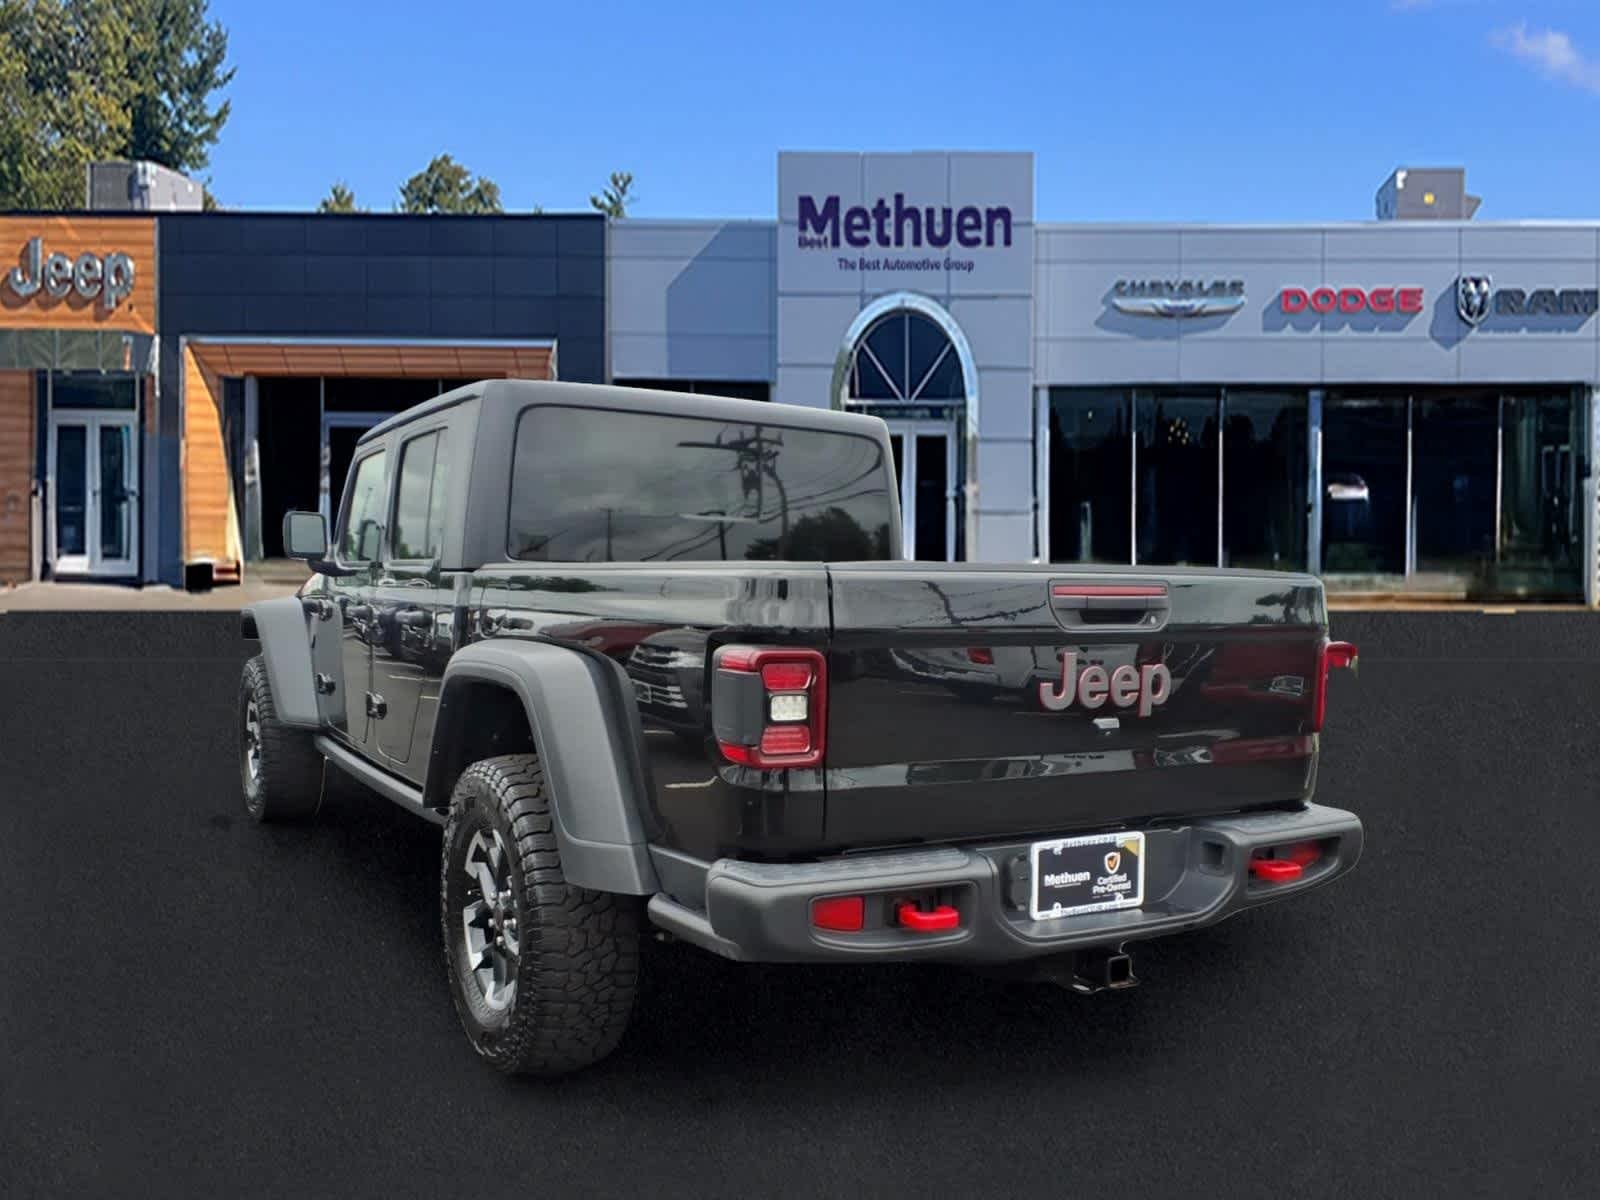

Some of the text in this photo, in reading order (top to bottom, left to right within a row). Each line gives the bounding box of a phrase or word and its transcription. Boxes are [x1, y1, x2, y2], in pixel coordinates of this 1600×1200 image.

[798, 193, 1012, 248] Methuen
[9, 237, 135, 309] Jeep
[837, 257, 975, 274] The Best Automotive Group
[1114, 280, 1245, 296] CHRYSLER
[1281, 287, 1424, 314] DODGE
[1495, 288, 1598, 315] RAM
[1039, 651, 1172, 718] Jeep
[1044, 871, 1091, 887] Methuen
[1092, 880, 1132, 894] Pre-Owned
